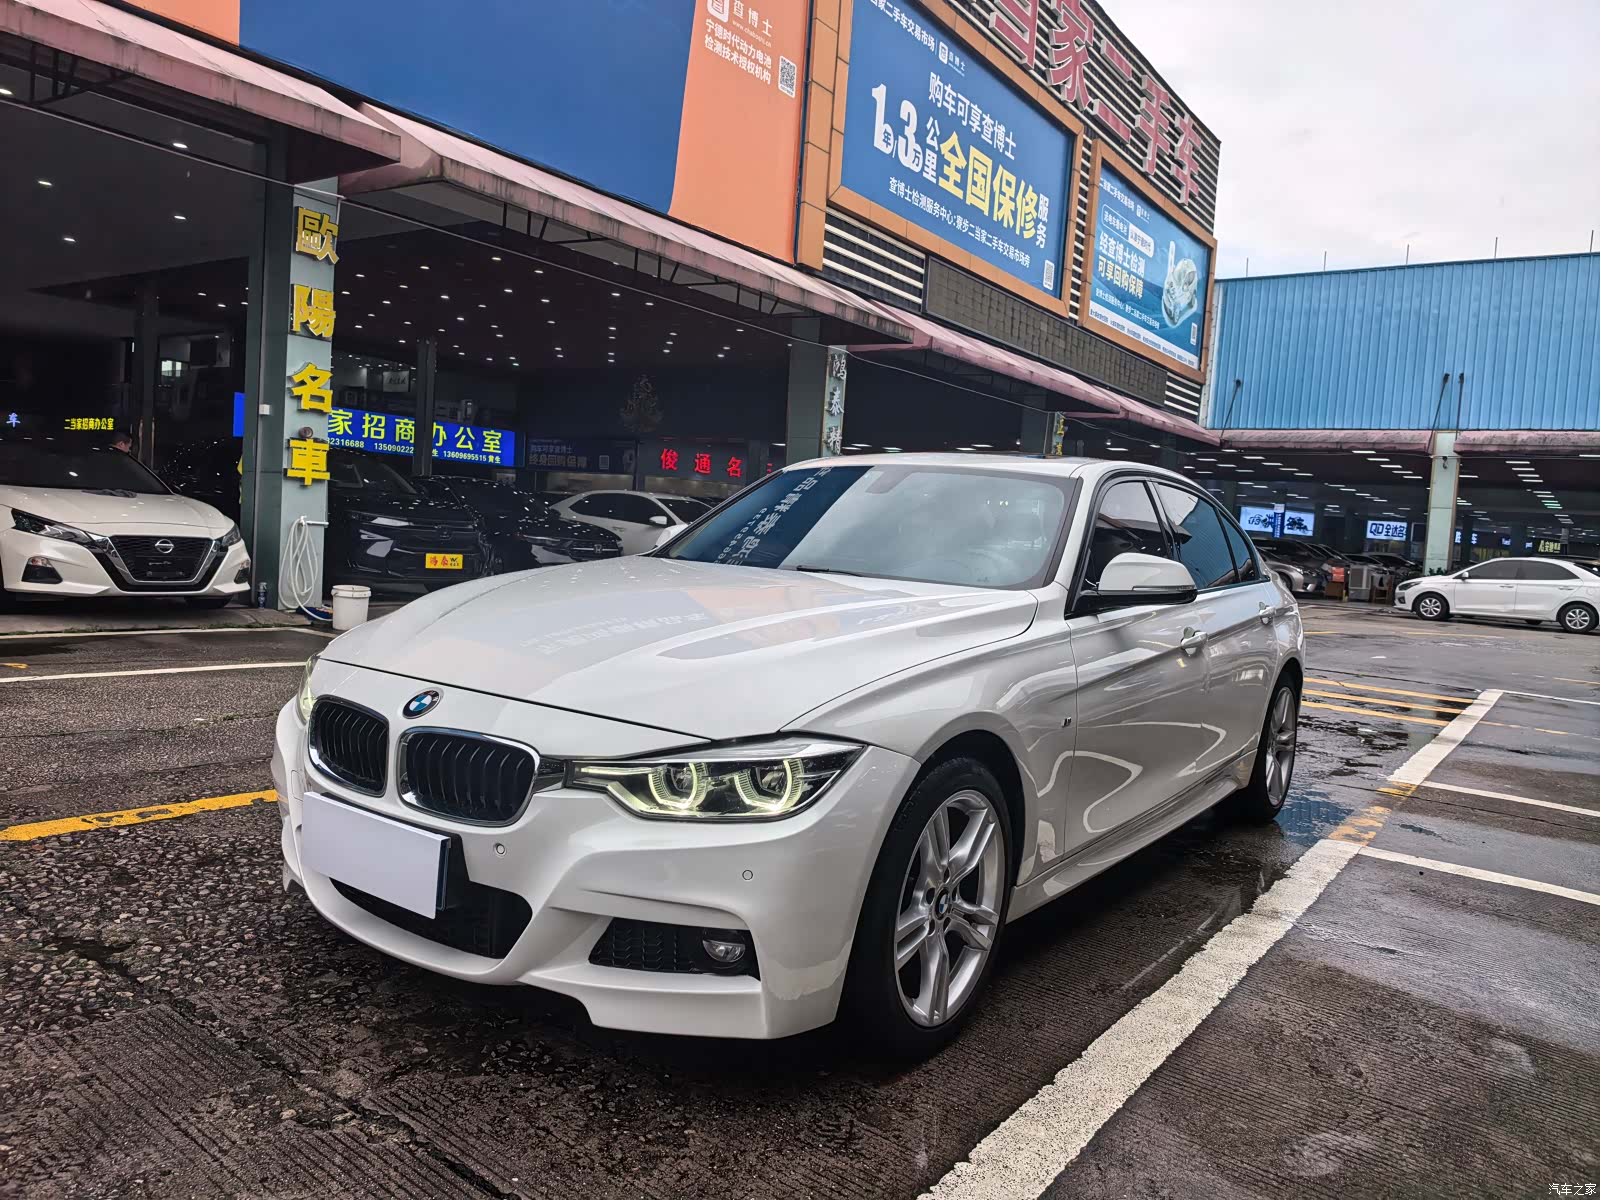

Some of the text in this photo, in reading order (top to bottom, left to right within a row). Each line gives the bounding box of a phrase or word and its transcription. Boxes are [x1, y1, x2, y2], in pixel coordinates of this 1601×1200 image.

[704, 34, 772, 85] 检测技术授权机构
[705, 18, 772, 69] 宁德时代动力电池
[928, 71, 1017, 160] 购车可享查博士
[1098, 254, 1144, 299] 可享回购保障
[1099, 231, 1146, 278] 经查博士检测
[286, 206, 339, 486] 歐陽名車
[63, 418, 115, 431] 二当家招商办公室
[660, 448, 743, 478] 俊通名
